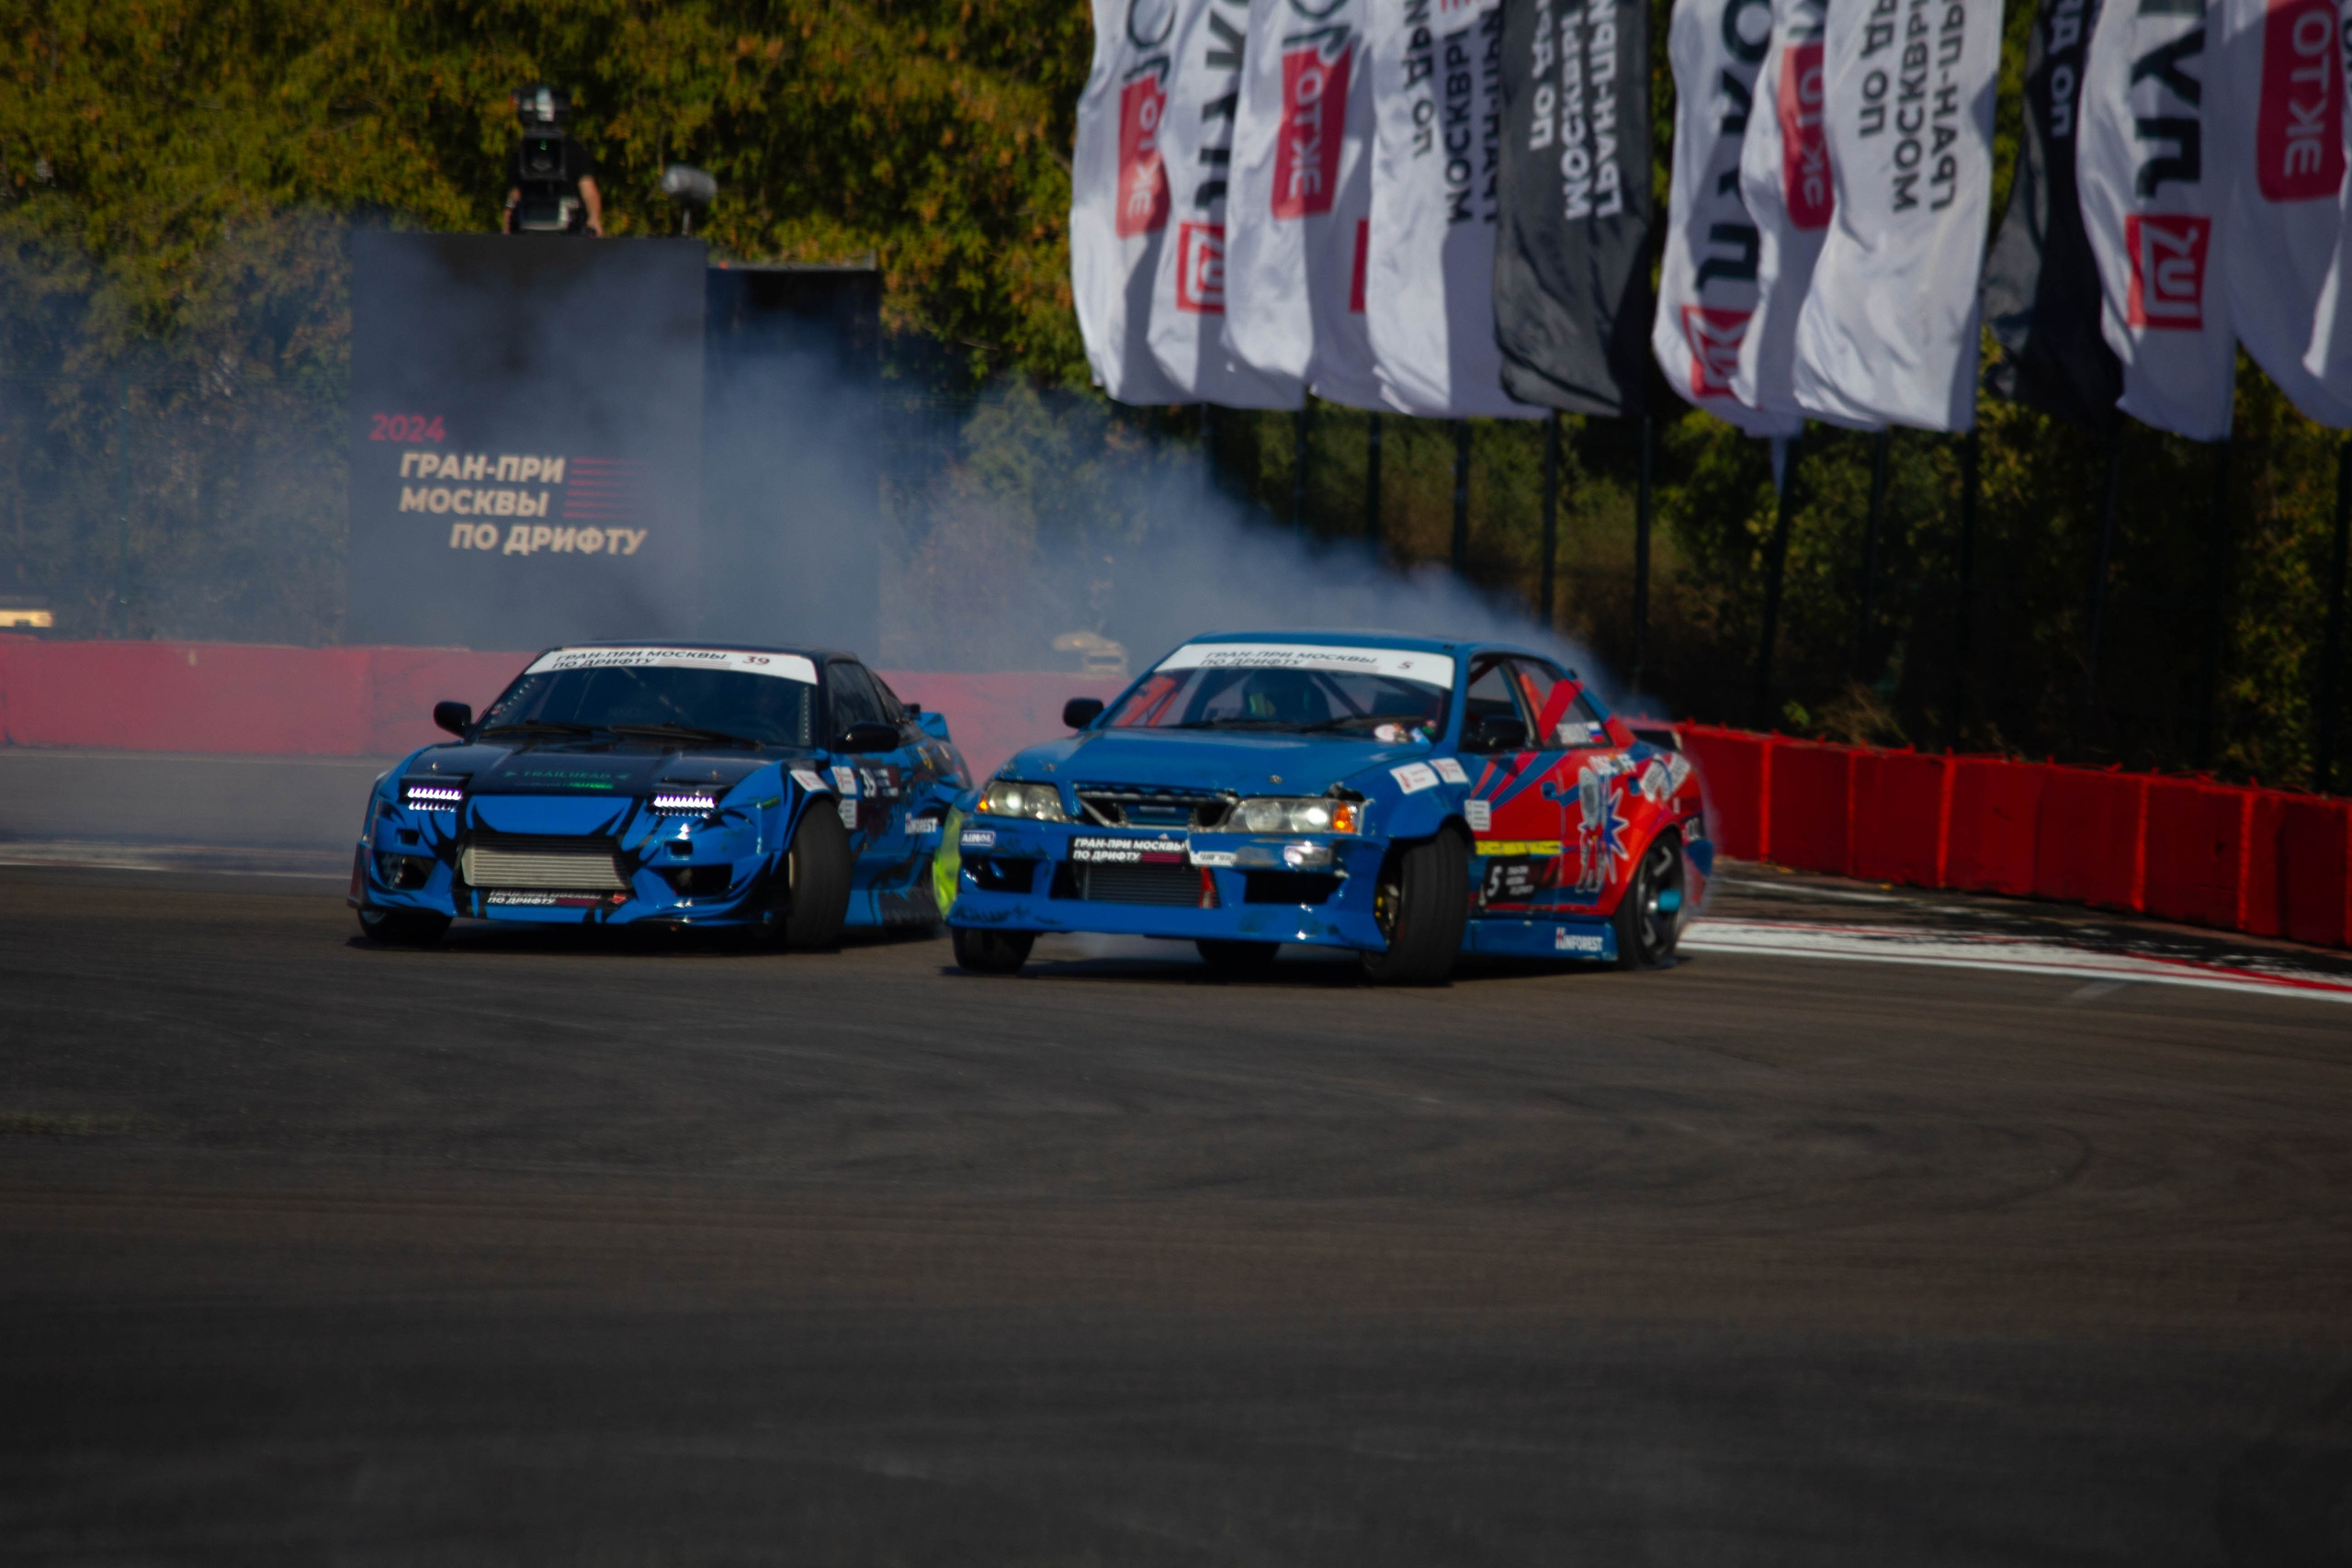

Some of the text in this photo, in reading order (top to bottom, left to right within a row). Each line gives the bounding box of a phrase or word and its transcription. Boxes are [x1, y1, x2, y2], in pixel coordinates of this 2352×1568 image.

[368, 413, 447, 443] 2024
[399, 451, 566, 484] ГРАН-ПРИ
[398, 486, 549, 517] МОСКВЫ
[449, 523, 648, 556] ПО ДРИФТУ
[556, 650, 727, 662] ГРАН-ПРИ МОСКВЫ
[741, 655, 771, 666] 39
[1205, 651, 1378, 663] ГРАН-ПРИ МОСКВЫ
[552, 658, 655, 669] ПО ДРИФТУ
[1227, 658, 1305, 667] ДРИФТУ
[1397, 660, 1413, 671] 5
[961, 832, 992, 843] AIMOL
[1073, 837, 1186, 852] ГРАН-ПРИ МОСКВЫ
[1073, 850, 1141, 863] ПО ДРИФТУ
[1487, 864, 1503, 897] 5
[506, 897, 556, 906] ДРИФТУ
